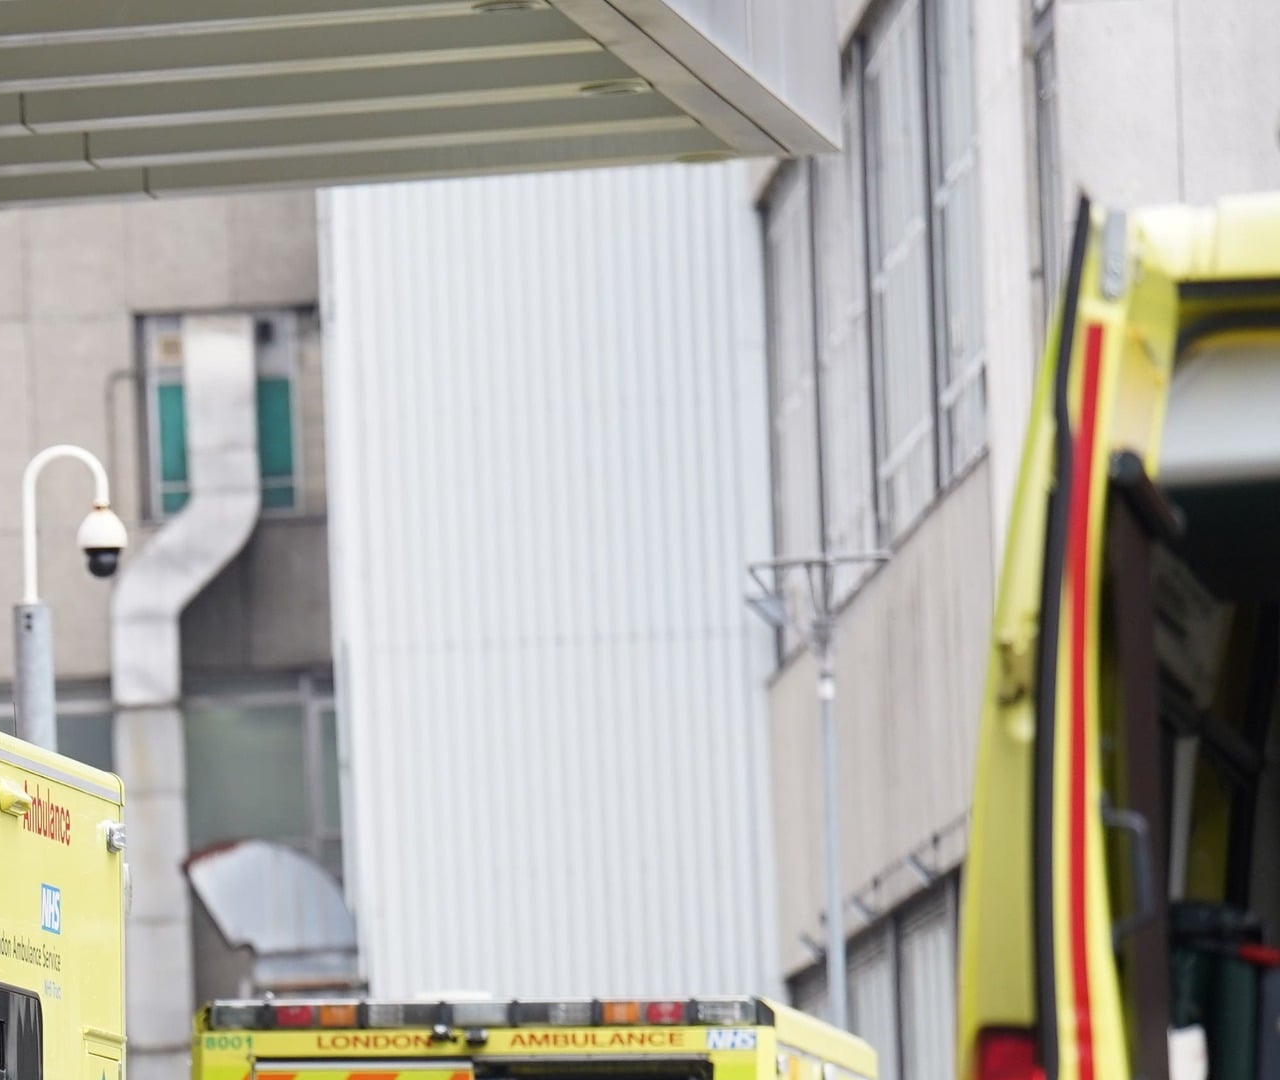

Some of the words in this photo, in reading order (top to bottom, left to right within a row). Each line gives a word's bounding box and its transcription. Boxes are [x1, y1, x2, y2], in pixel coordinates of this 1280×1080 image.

[41, 886, 60, 931] NHS
[13, 935, 41, 967] Ambulance
[42, 943, 61, 973] Service
[205, 1034, 254, 1050] 8001
[316, 1034, 434, 1050] LONDON
[510, 1031, 684, 1048] AMBULANCE
[706, 1029, 757, 1049] NHS
